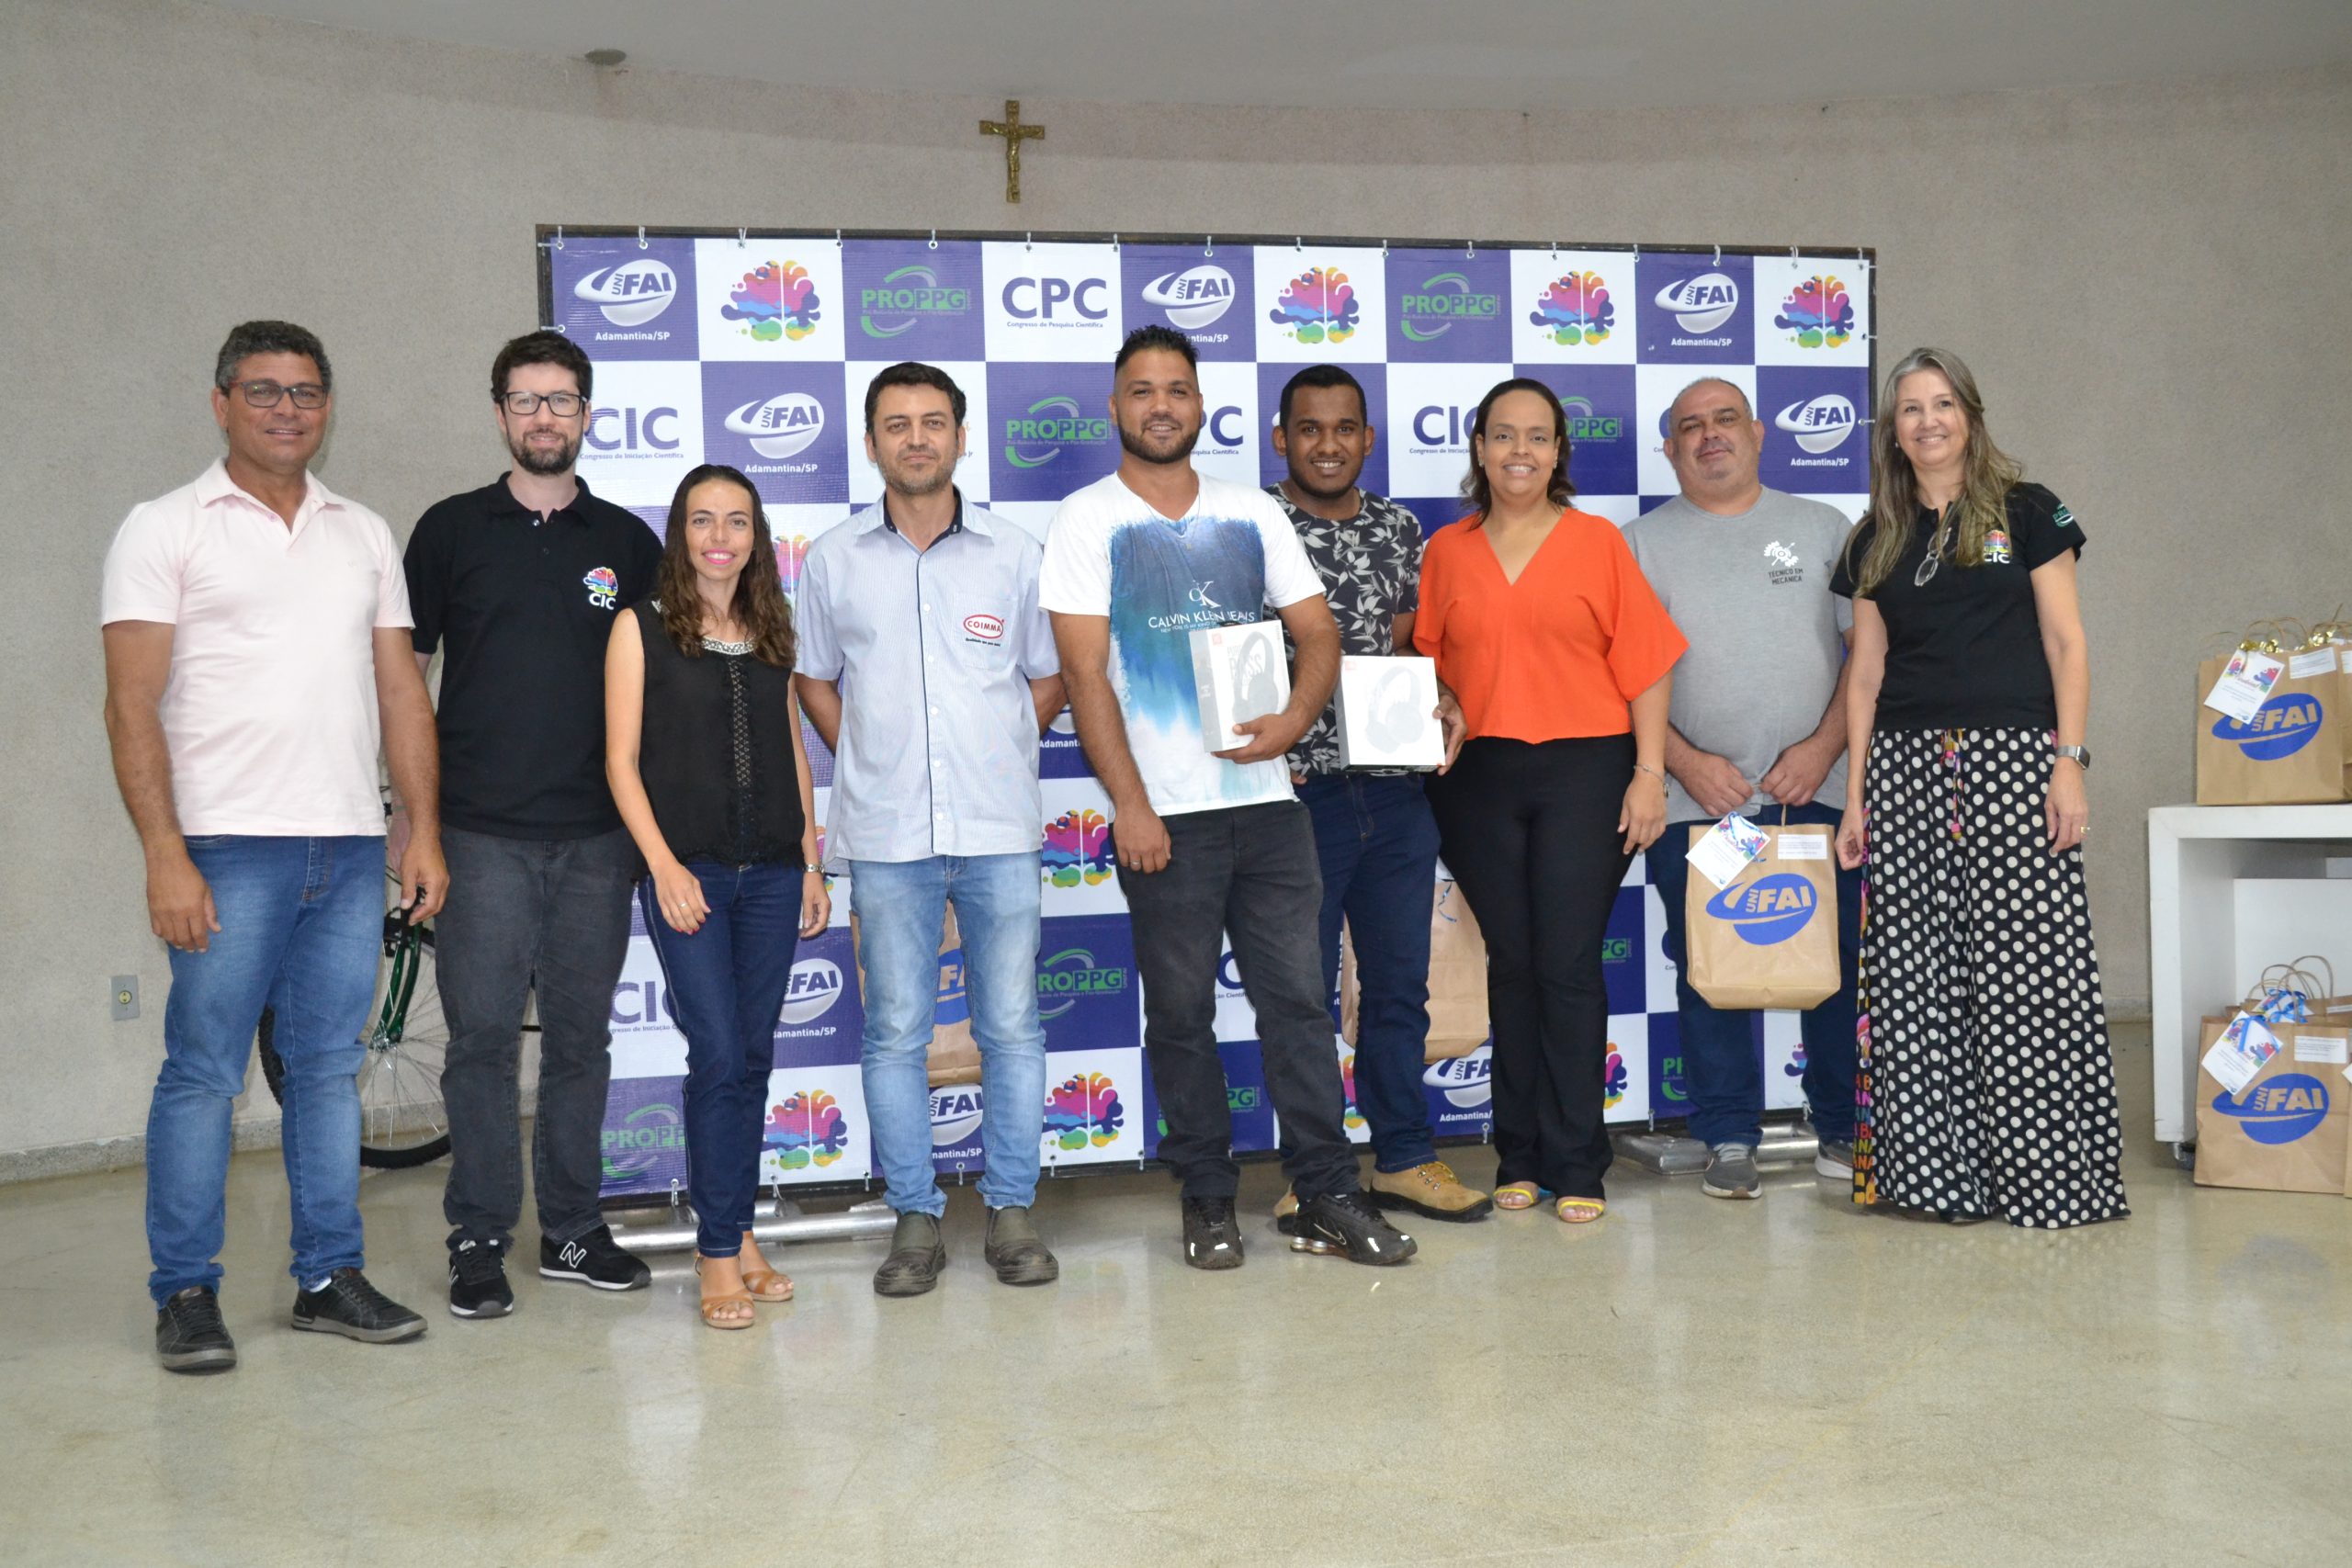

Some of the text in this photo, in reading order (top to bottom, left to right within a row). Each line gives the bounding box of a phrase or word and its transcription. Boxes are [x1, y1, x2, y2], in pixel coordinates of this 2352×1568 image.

[862, 288, 966, 310] PROPPG
[1001, 276, 1108, 320] CPC
[1402, 294, 1496, 315] PROPPG
[595, 332, 670, 341] Adamantina/SP
[1186, 333, 1228, 343] ntina/SP
[1671, 338, 1733, 346] Adamantina/SP
[584, 406, 680, 450] CIC
[1006, 419, 1107, 440] PROPPG
[744, 463, 818, 473] Adamantina/SP
[1791, 457, 1849, 467] Adamantina/SP
[589, 592, 616, 610] CIC
[967, 621, 1001, 632] COIMMA
[1148, 614, 1191, 628] CALVIN
[1039, 739, 1078, 748] Adamant
[1038, 967, 1122, 992] ROPPG
[610, 981, 670, 1024] CI
[1464, 1058, 1491, 1080] FA
[1440, 1110, 1493, 1122] Adamantina/
